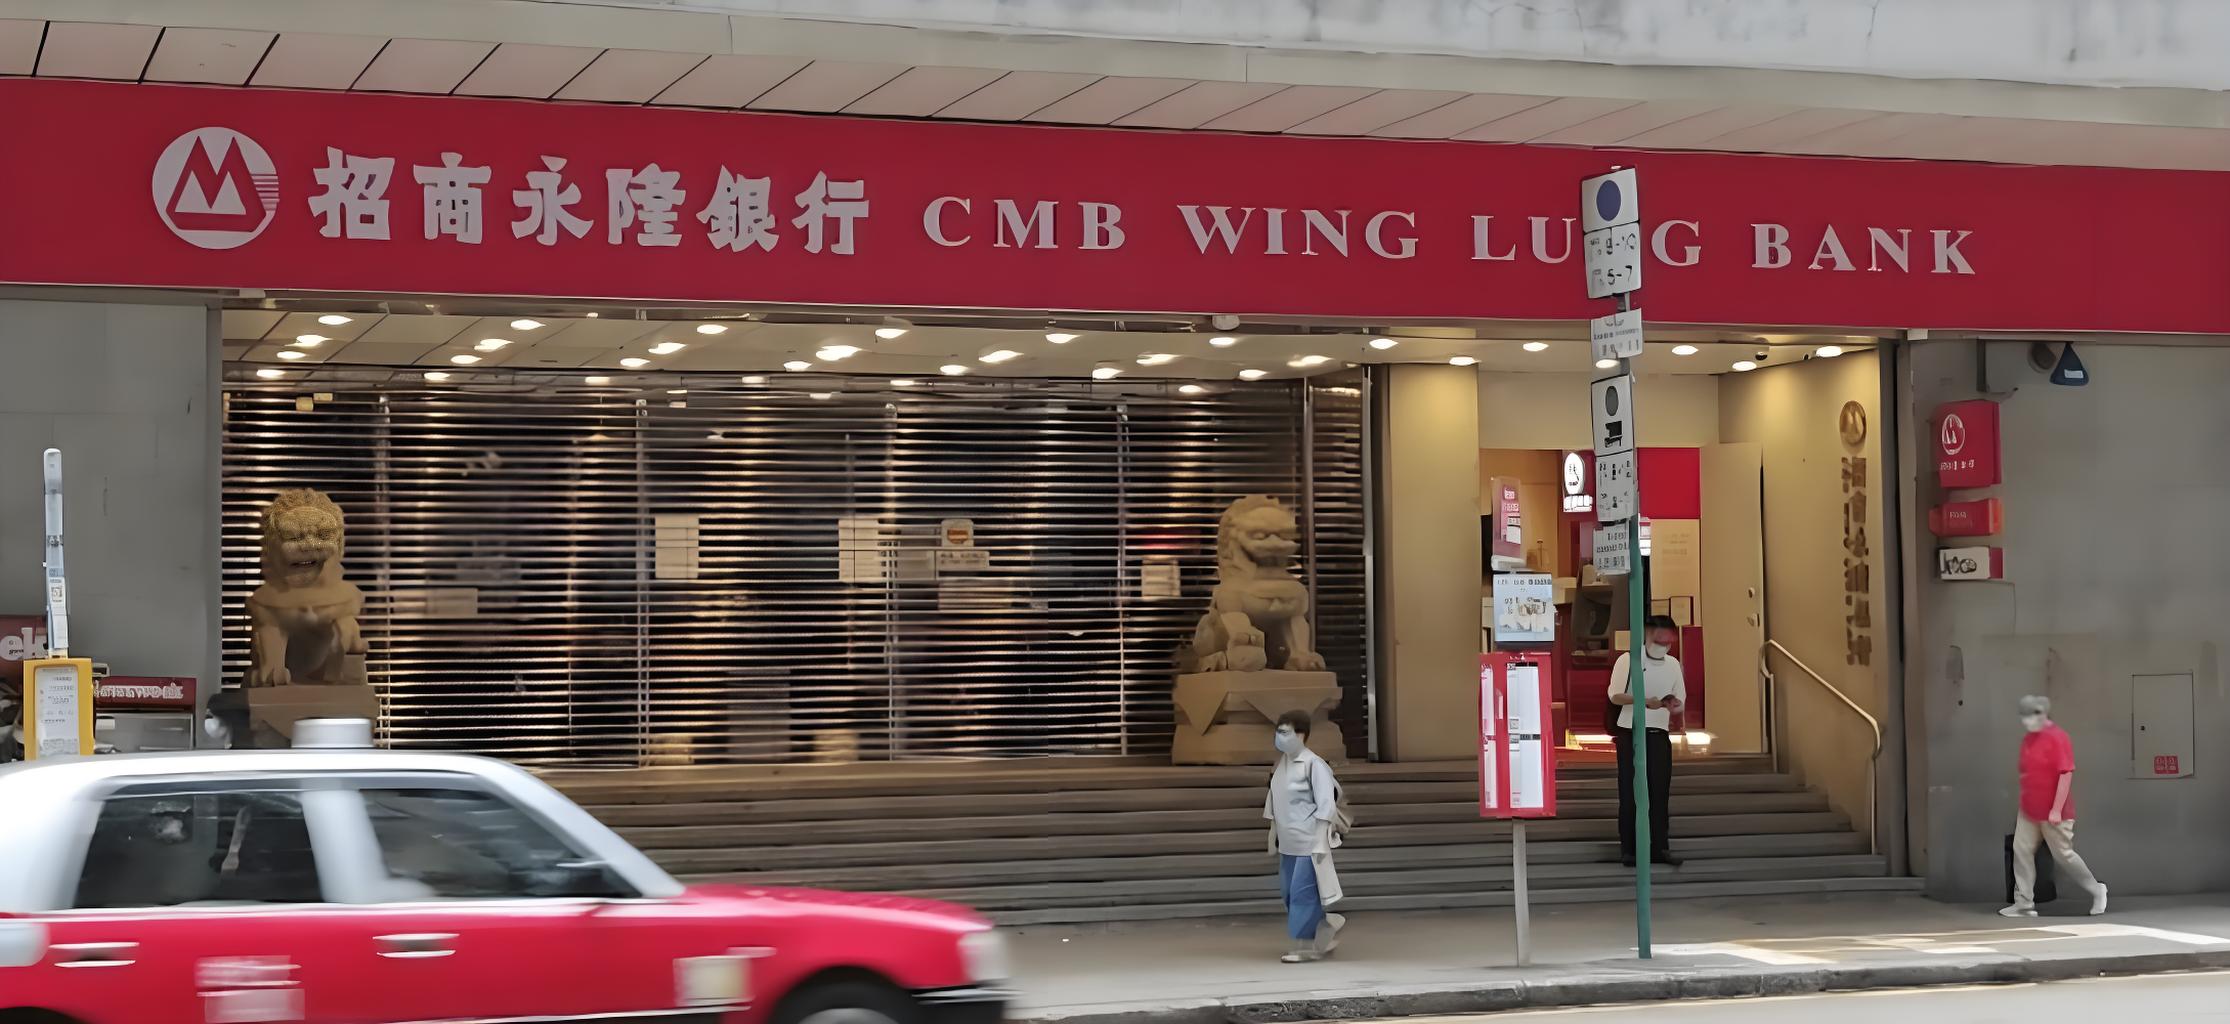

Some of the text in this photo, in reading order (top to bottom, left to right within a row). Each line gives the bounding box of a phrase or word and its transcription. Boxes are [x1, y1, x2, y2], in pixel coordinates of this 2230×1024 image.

[307, 146, 870, 255] 招商永隆銀行
[923, 196, 1976, 275] CMB WING LUG BANK
